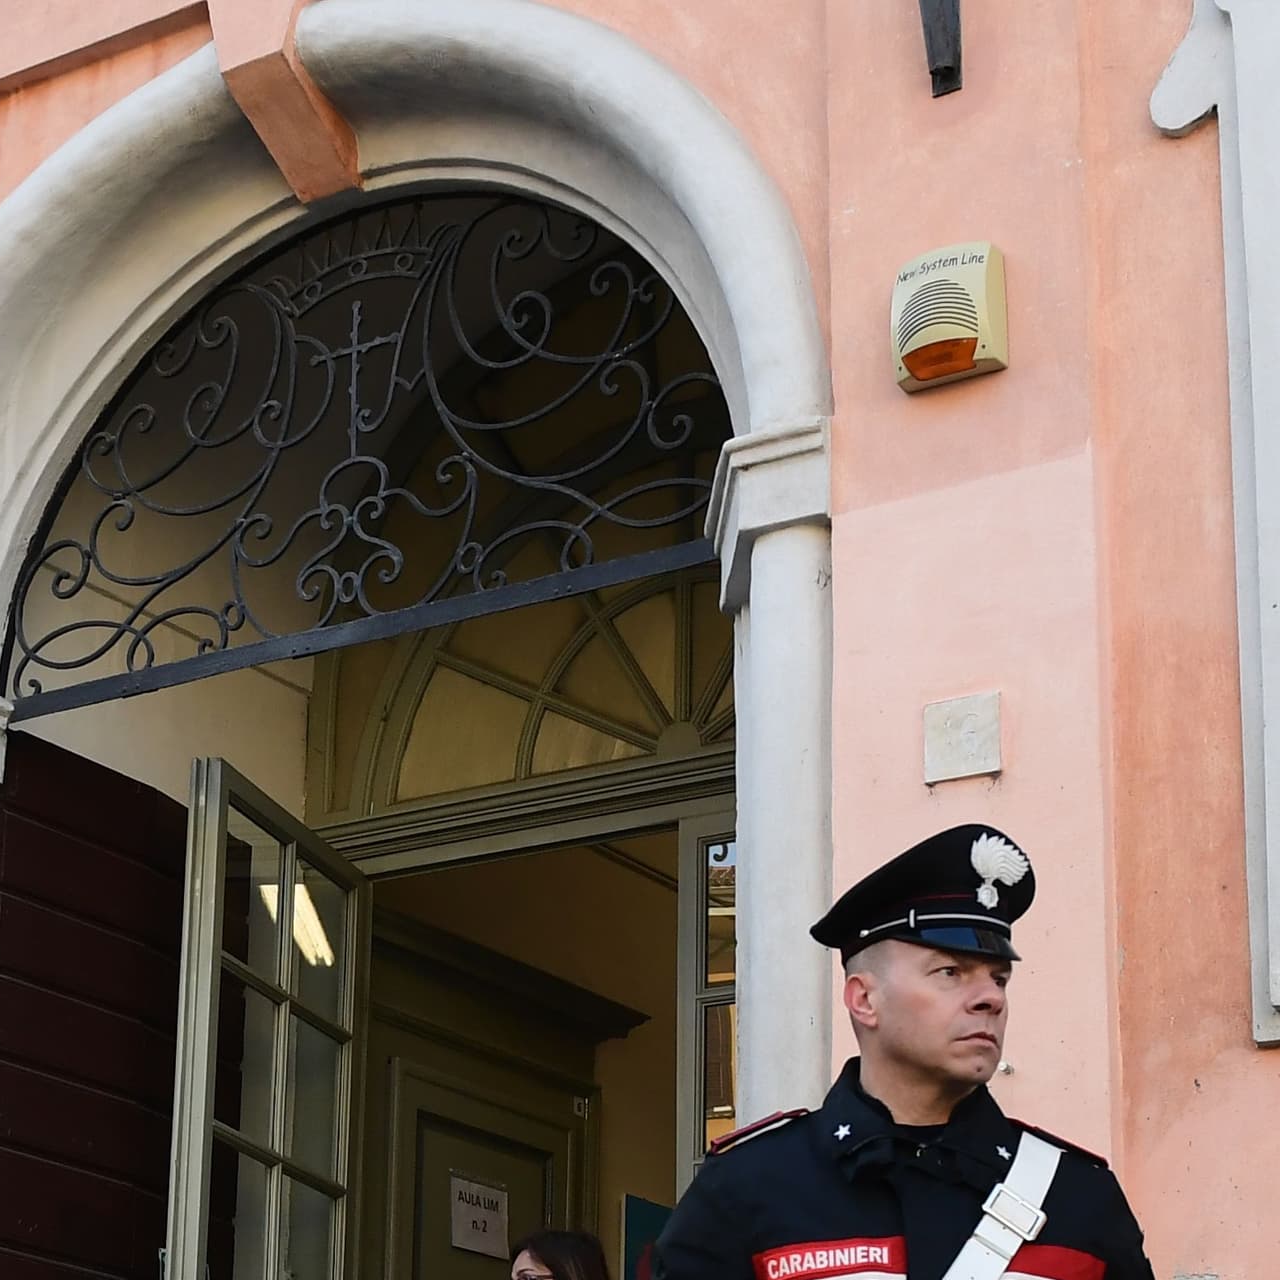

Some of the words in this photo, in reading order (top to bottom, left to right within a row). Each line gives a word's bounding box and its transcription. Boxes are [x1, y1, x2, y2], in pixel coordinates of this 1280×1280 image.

[919, 256, 959, 276] System
[961, 251, 985, 265] Line
[458, 1190, 481, 1208] AULA
[482, 1220, 487, 1233] 2
[767, 1246, 889, 1279] CARABINIERI
